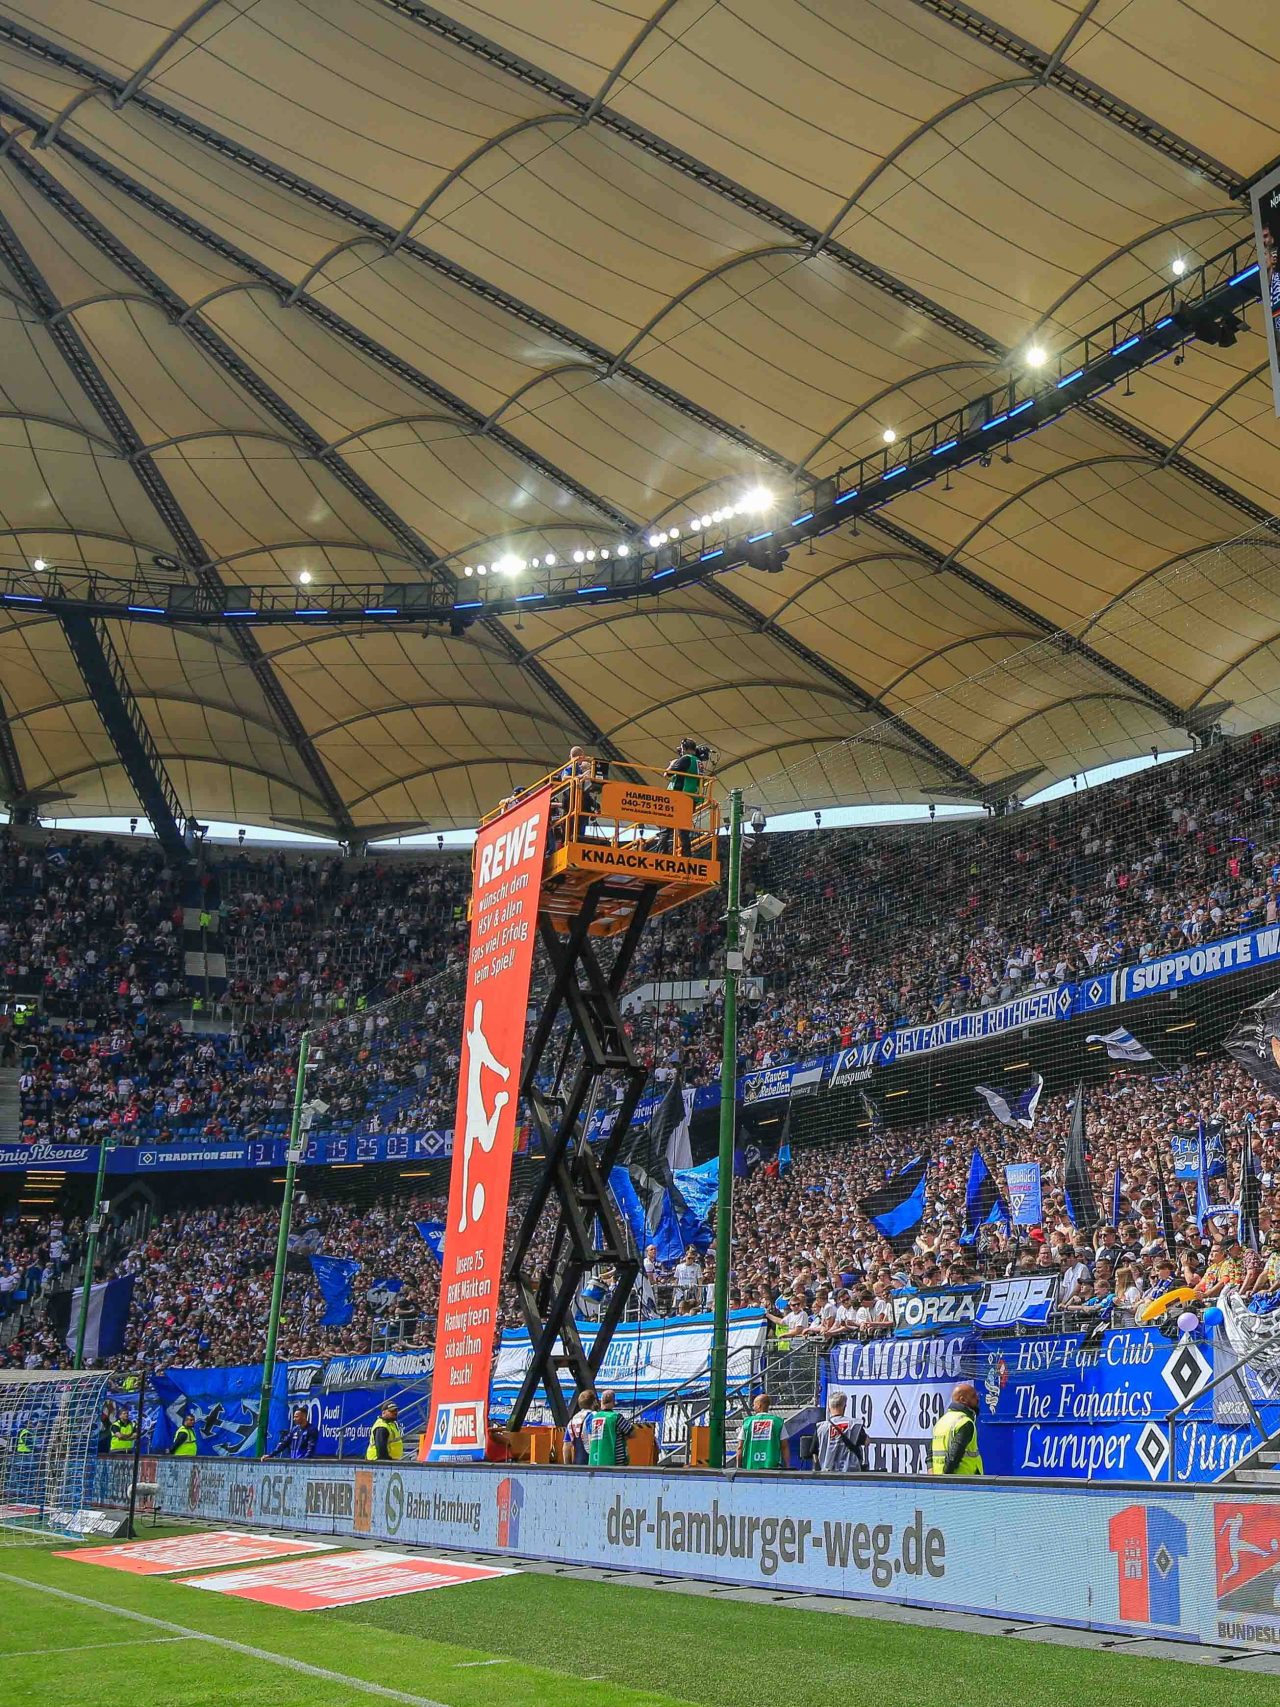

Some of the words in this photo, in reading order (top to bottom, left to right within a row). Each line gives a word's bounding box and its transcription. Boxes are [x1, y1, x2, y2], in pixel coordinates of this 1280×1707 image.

[621, 798, 652, 810] 040-75
[653, 803, 664, 812] 12
[625, 791, 670, 804] HAMBURG
[478, 812, 542, 888] REWE
[582, 848, 708, 877] KNAACK-KRANE
[478, 881, 509, 913] wünscht
[510, 872, 530, 895] dem
[477, 912, 493, 937] HSV
[500, 899, 523, 923] allen
[485, 930, 501, 954] viel
[501, 918, 529, 947] Erfolg
[1132, 939, 1252, 993] SUPPORTE
[895, 1030, 918, 1055] HSV
[922, 1026, 946, 1050] FAN
[950, 1014, 983, 1043] CLUB
[987, 993, 1057, 1033] ROTHOSEN
[759, 1082, 791, 1098] Rebellen
[29, 1143, 88, 1160] Pilsener
[158, 1150, 218, 1162] TRADITION
[220, 1150, 244, 1160] SEIT
[357, 1137, 378, 1155] 25
[387, 1136, 409, 1155] 03
[474, 1249, 484, 1271] 75
[894, 1294, 976, 1325] FORZA
[836, 1335, 966, 1381] HAMBURG
[1017, 1333, 1154, 1379] HSV-Fan-Club
[323, 1405, 340, 1420] Audi
[850, 1394, 874, 1429] 19
[918, 1392, 945, 1430] 89
[1015, 1385, 1050, 1419] The
[1057, 1386, 1153, 1418] Fanatics
[753, 1452, 767, 1461] 03
[1021, 1422, 1131, 1470] Luruper
[305, 1481, 353, 1516] REYHER
[406, 1492, 431, 1520] Bahn
[432, 1493, 482, 1533] Hamburg
[607, 1495, 946, 1588] der-hamburger-weg.de
